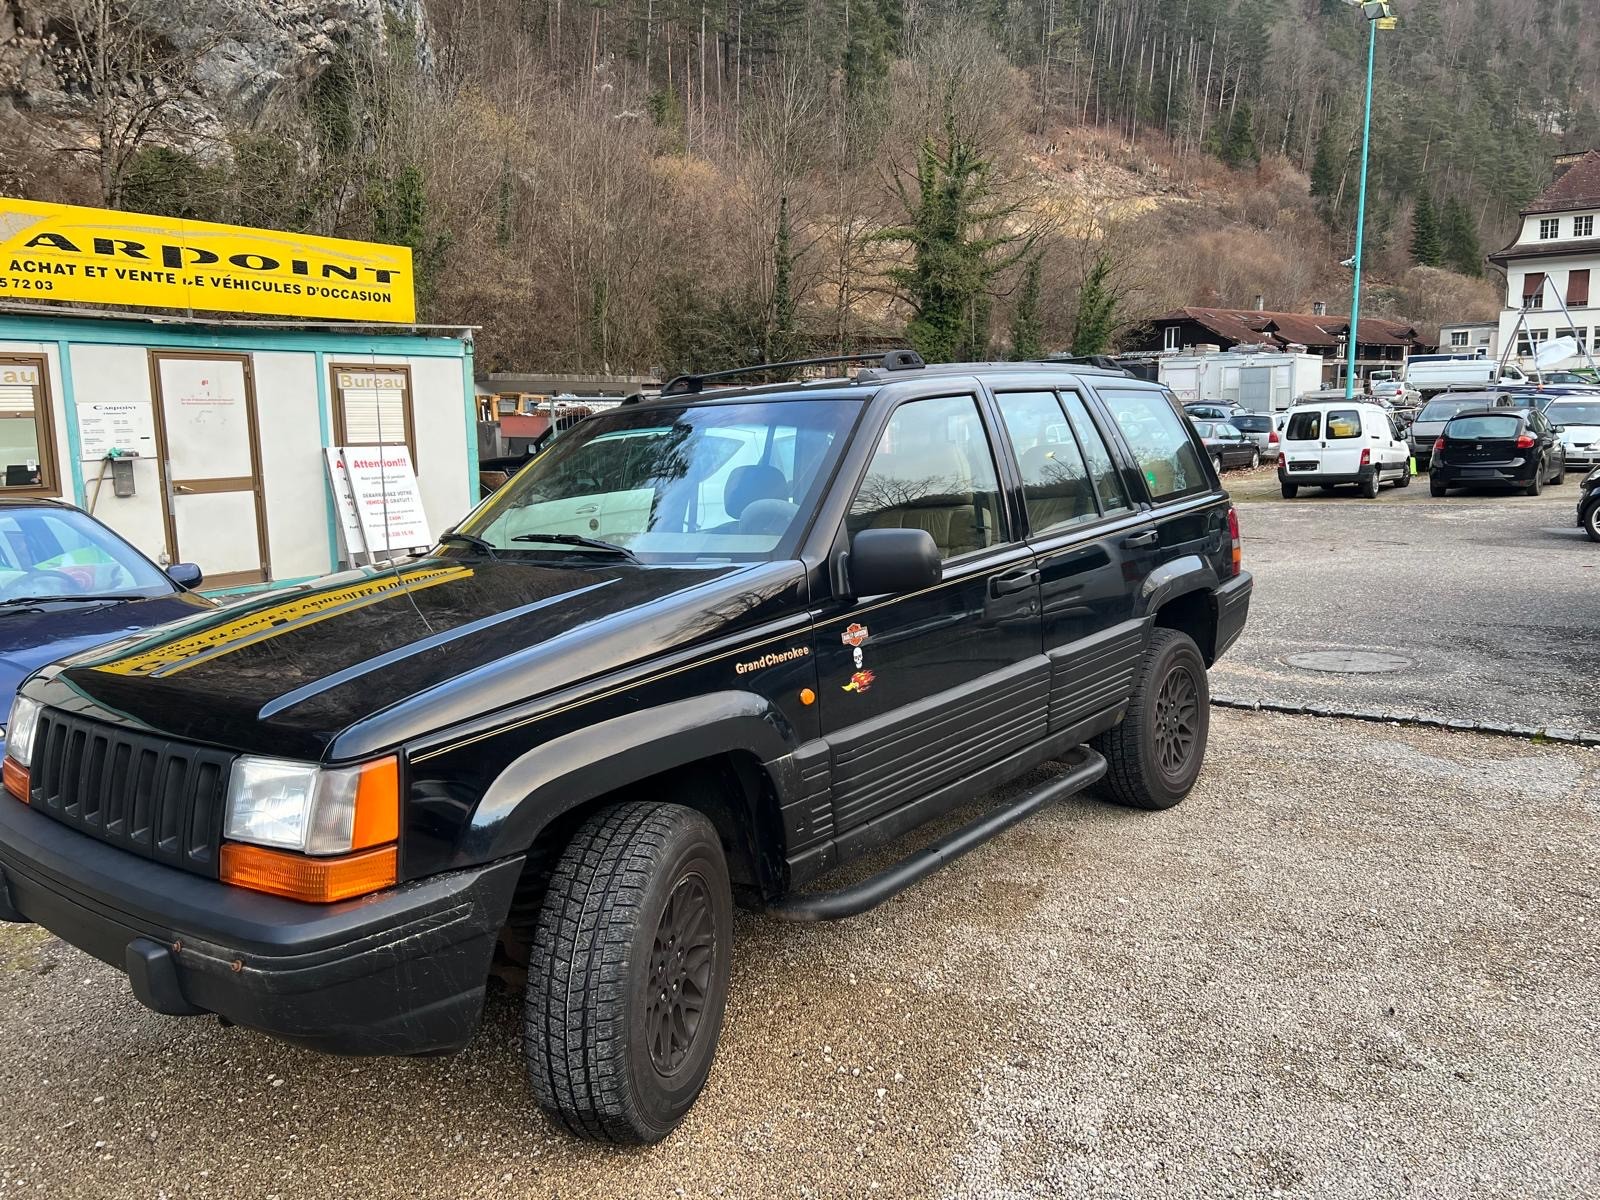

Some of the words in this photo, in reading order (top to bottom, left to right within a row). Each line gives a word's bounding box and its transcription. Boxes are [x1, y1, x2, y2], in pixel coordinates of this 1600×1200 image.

[9, 259, 77, 277] ACHAT
[85, 265, 108, 278] ET
[115, 268, 176, 285] VENTE
[210, 274, 301, 295] VÉHICULES
[306, 286, 392, 303] D'OCCASION
[12, 278, 31, 289] 72
[35, 280, 53, 290] 03
[340, 374, 404, 388] Bureau
[735, 655, 766, 675] Grand
[765, 646, 810, 667] Cherokee
